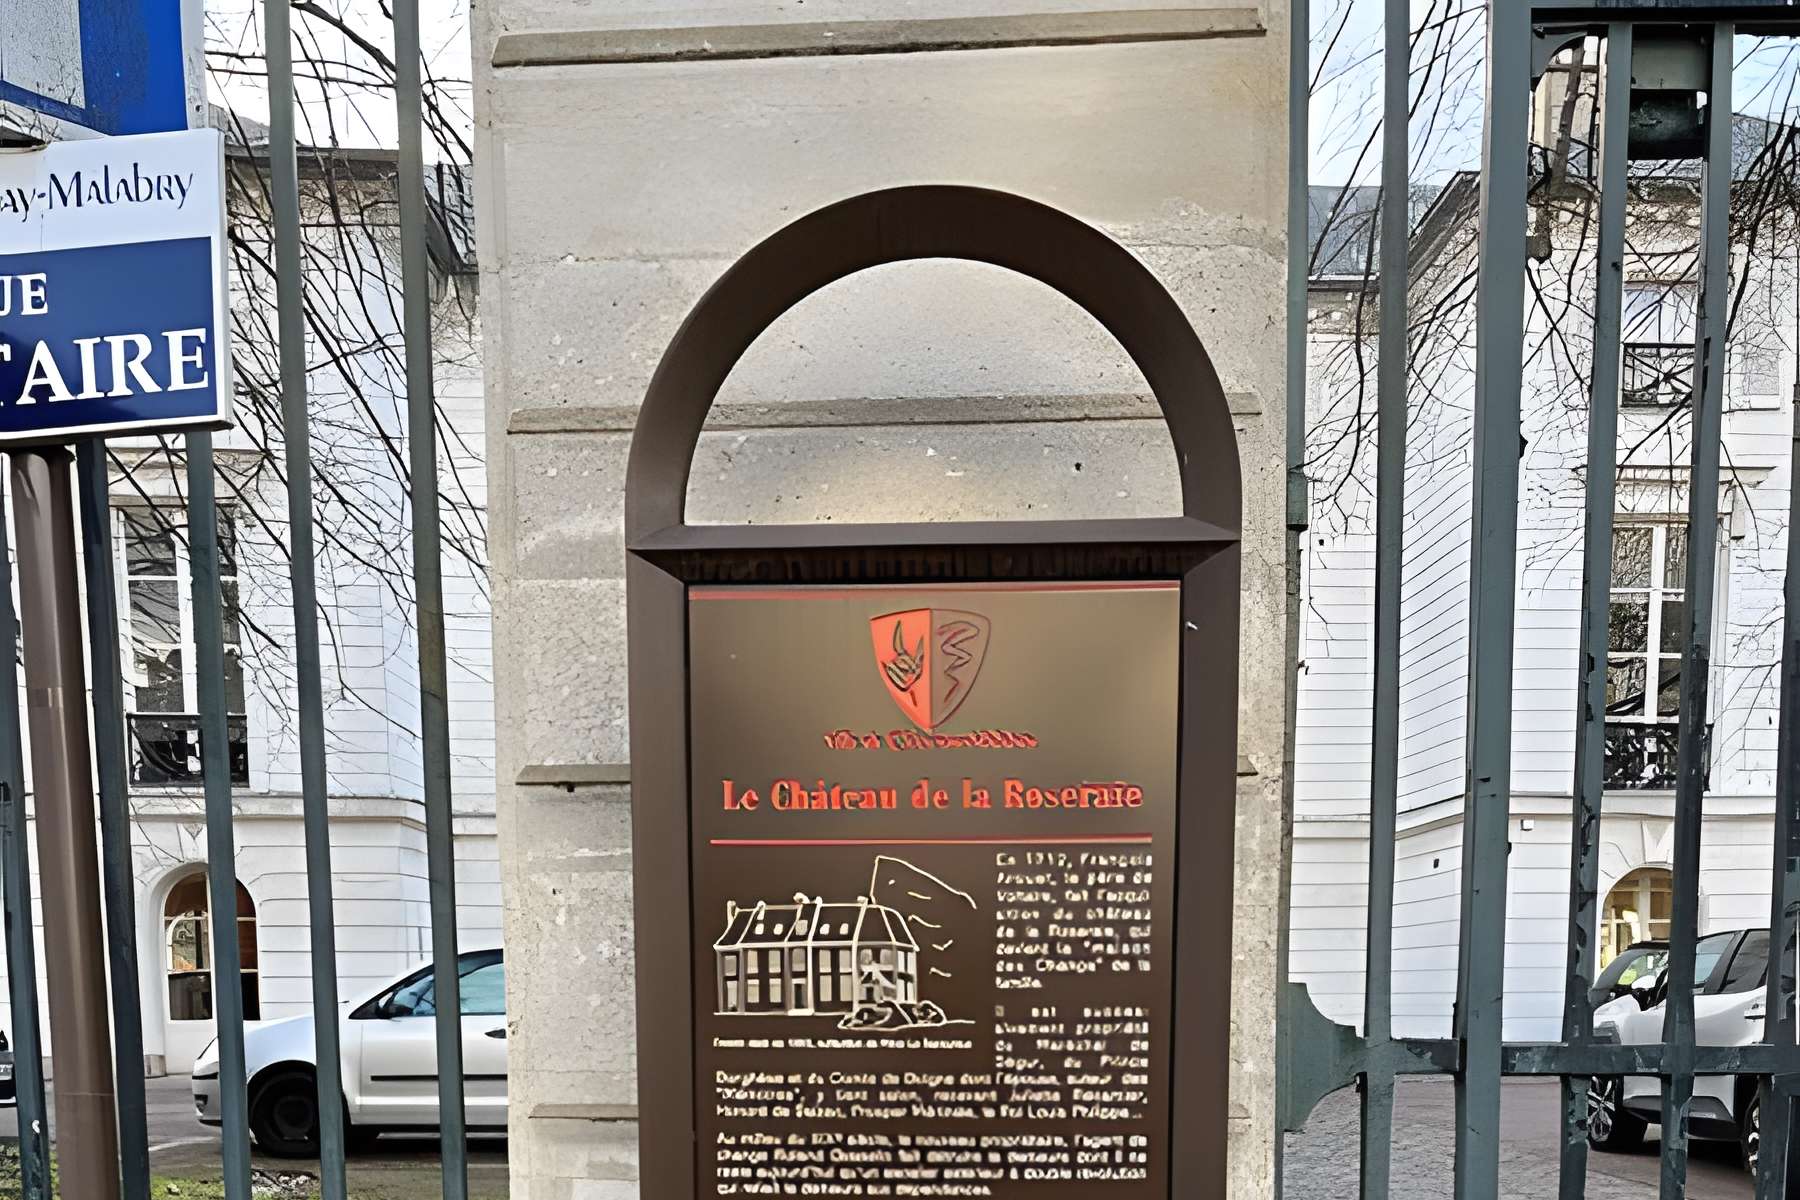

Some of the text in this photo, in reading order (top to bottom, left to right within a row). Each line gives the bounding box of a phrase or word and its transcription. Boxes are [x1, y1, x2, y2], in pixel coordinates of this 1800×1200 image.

[721, 779, 760, 811] Le
[911, 777, 949, 810] de
[962, 777, 992, 809] la
